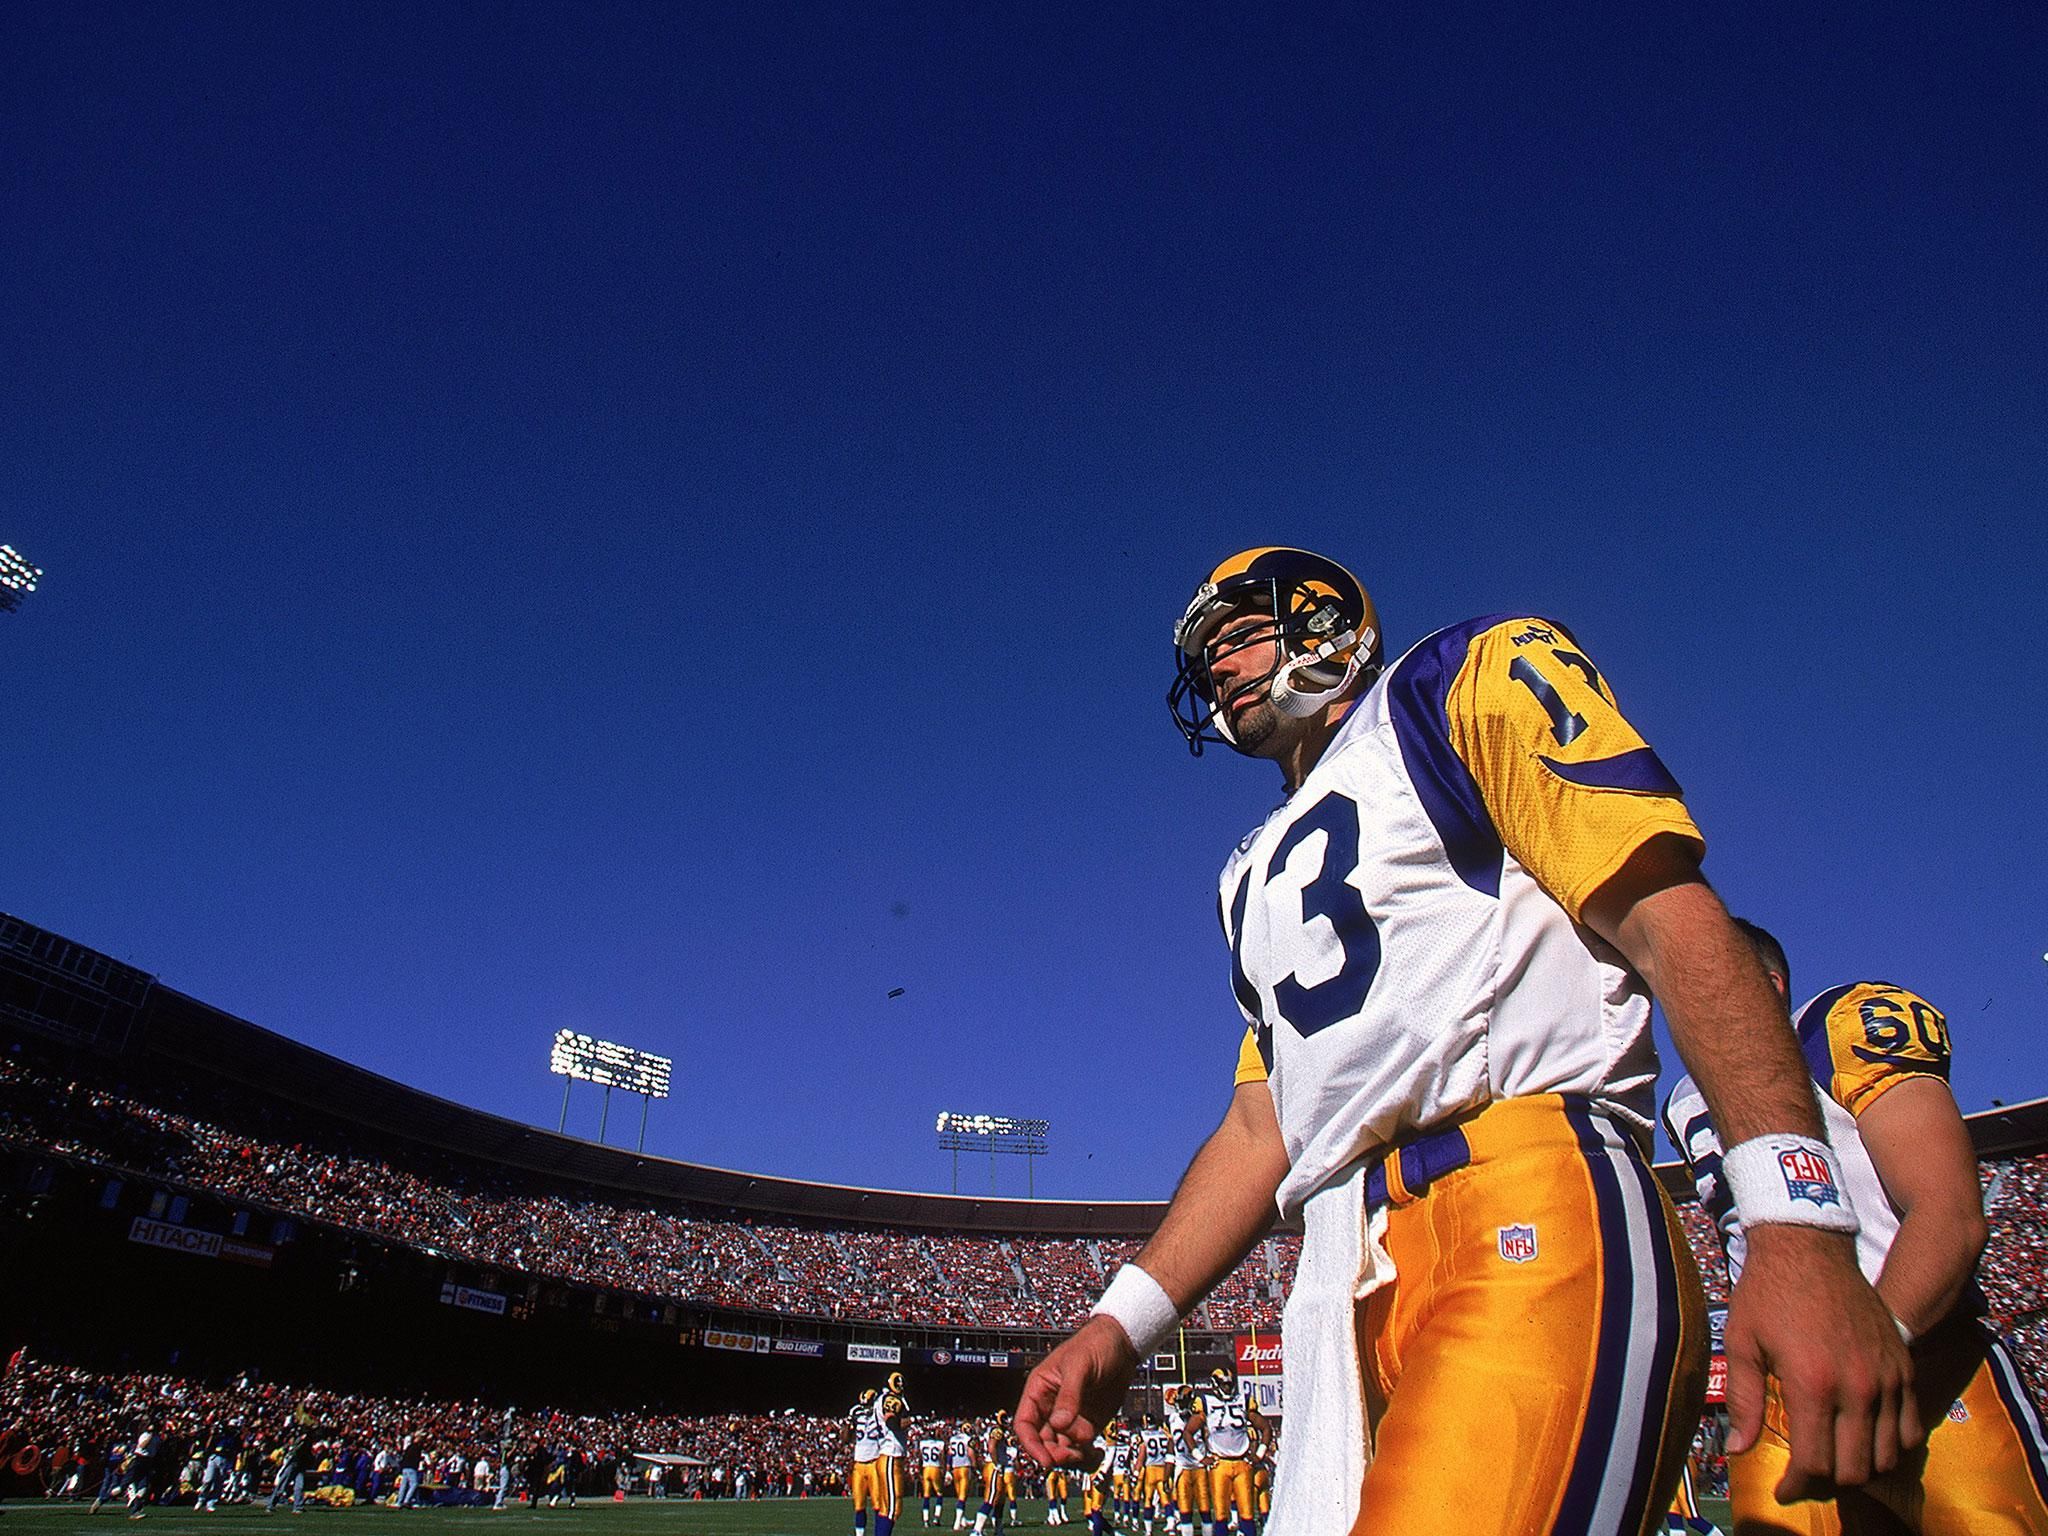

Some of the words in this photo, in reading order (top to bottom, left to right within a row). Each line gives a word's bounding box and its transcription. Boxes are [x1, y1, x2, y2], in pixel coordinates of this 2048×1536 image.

[1782, 1151, 1832, 1185] NFL
[132, 1220, 221, 1255] HITACHI
[1505, 1239, 1534, 1257] NFL
[775, 1341, 794, 1351] BUD
[794, 1343, 819, 1354] LIGHT
[954, 1354, 987, 1364] PREFERS
[1210, 1404, 1246, 1430] 75
[922, 1446, 940, 1463] 56
[1147, 1437, 1169, 1458] 95
